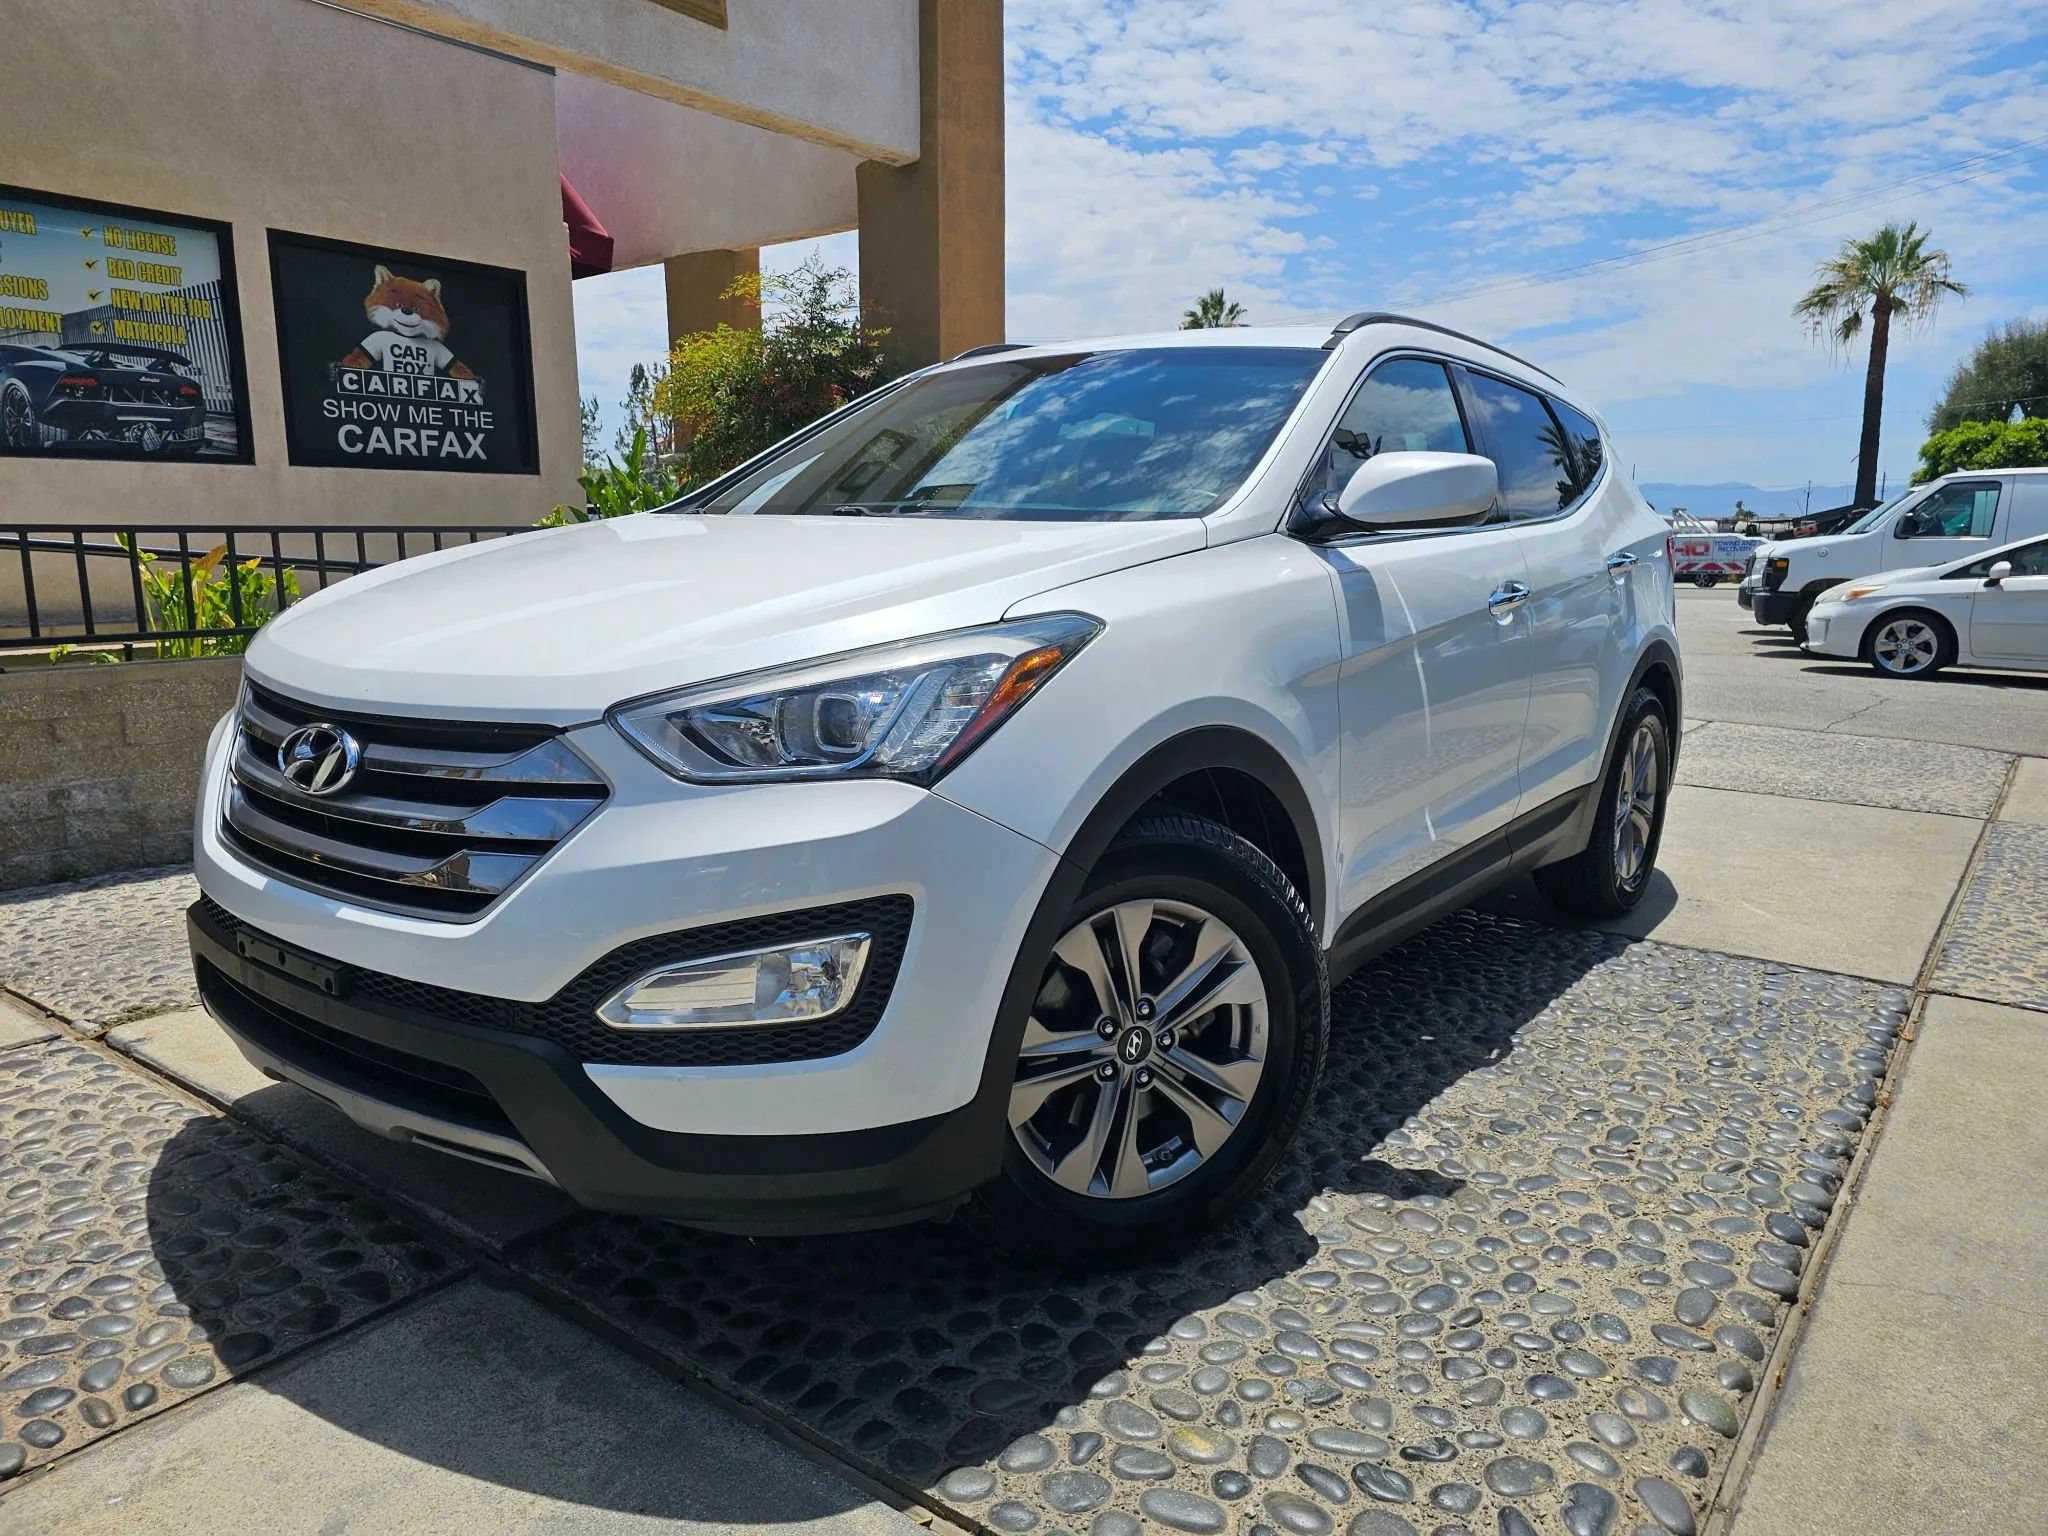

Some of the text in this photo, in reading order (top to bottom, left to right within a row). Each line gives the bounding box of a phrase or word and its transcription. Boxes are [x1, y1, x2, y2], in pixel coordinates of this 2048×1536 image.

[103, 225, 177, 256] NO LICENSE
[107, 257, 182, 286] BAD CREDIT
[111, 288, 211, 319] NEW ON THE JOB
[113, 319, 186, 345] MATRICULA
[390, 344, 427, 362] CAR
[393, 360, 426, 375] FOX
[343, 373, 480, 404] CARFAX
[323, 400, 494, 429] SHOW ME THE
[337, 424, 487, 460] CARFAX
